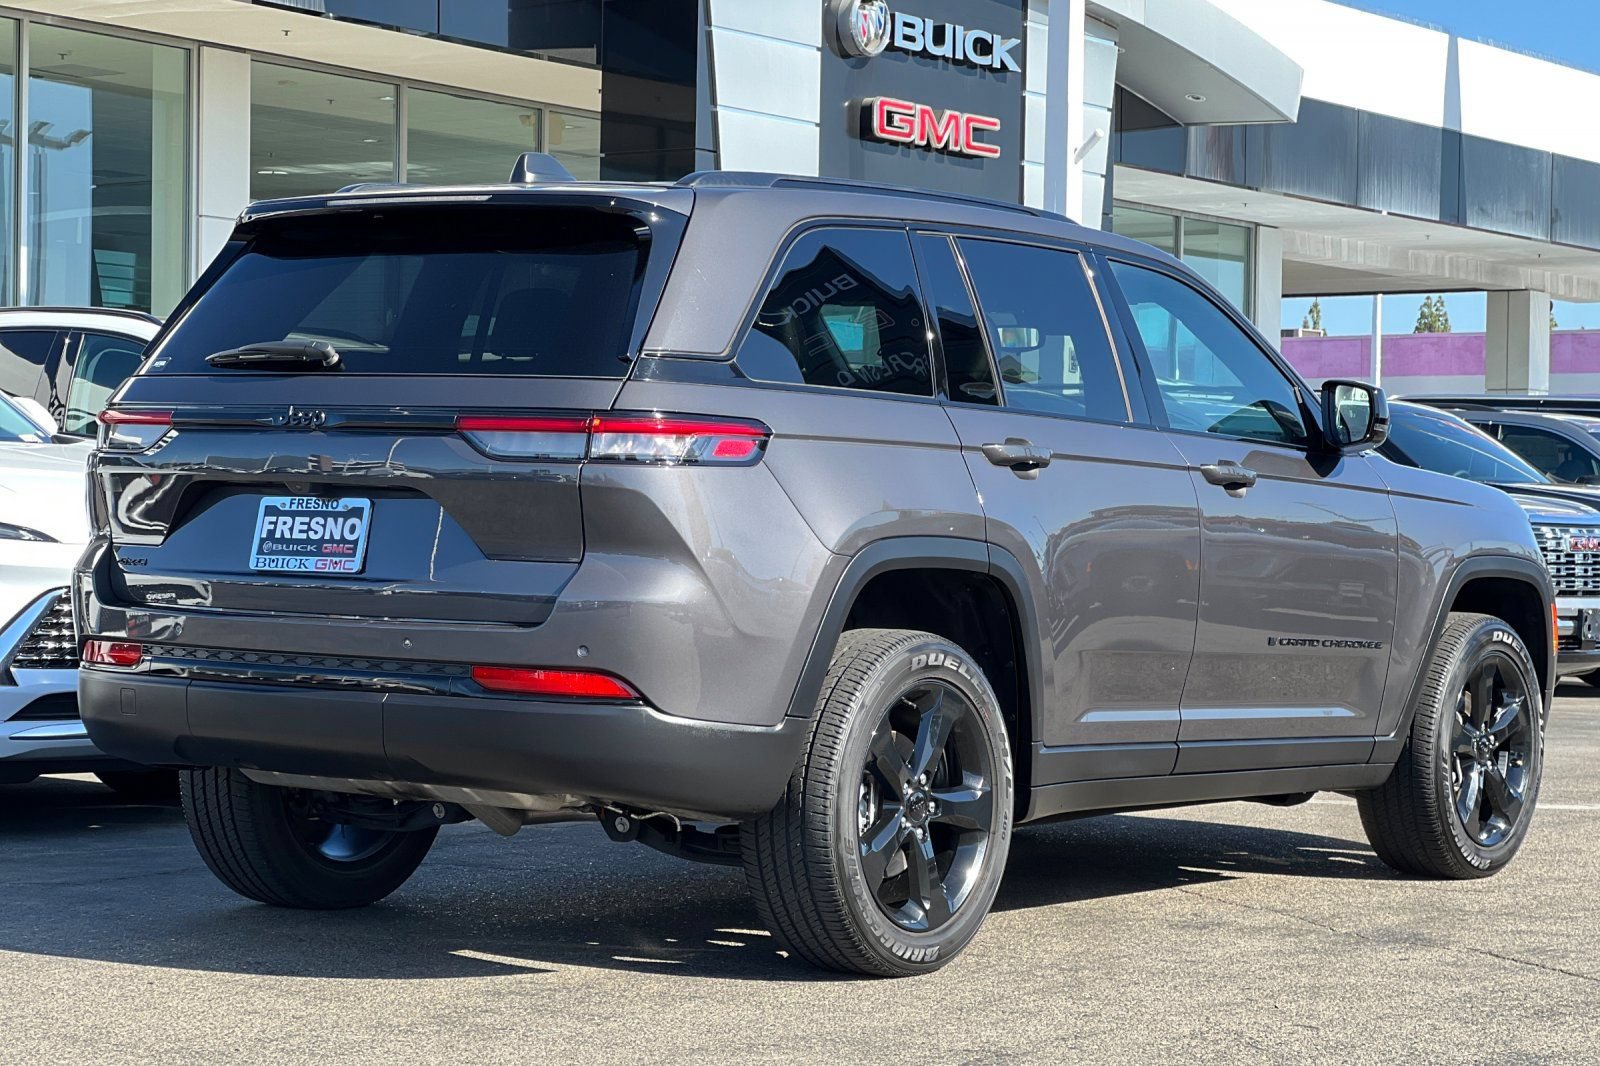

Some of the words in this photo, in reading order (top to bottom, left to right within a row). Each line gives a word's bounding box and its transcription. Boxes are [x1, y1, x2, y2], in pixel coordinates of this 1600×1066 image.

[894, 12, 1021, 72] BUICK
[873, 96, 1001, 159] GMC
[279, 404, 326, 430] Jeep
[289, 498, 339, 509] FRESNO
[261, 516, 361, 540] FRESNO
[321, 544, 354, 553] GMC
[1571, 536, 1600, 551] GM
[255, 557, 311, 570] BUICK
[314, 558, 355, 571] GMC
[1279, 637, 1319, 648] GRAND
[1321, 639, 1384, 650] CHEROKEE
